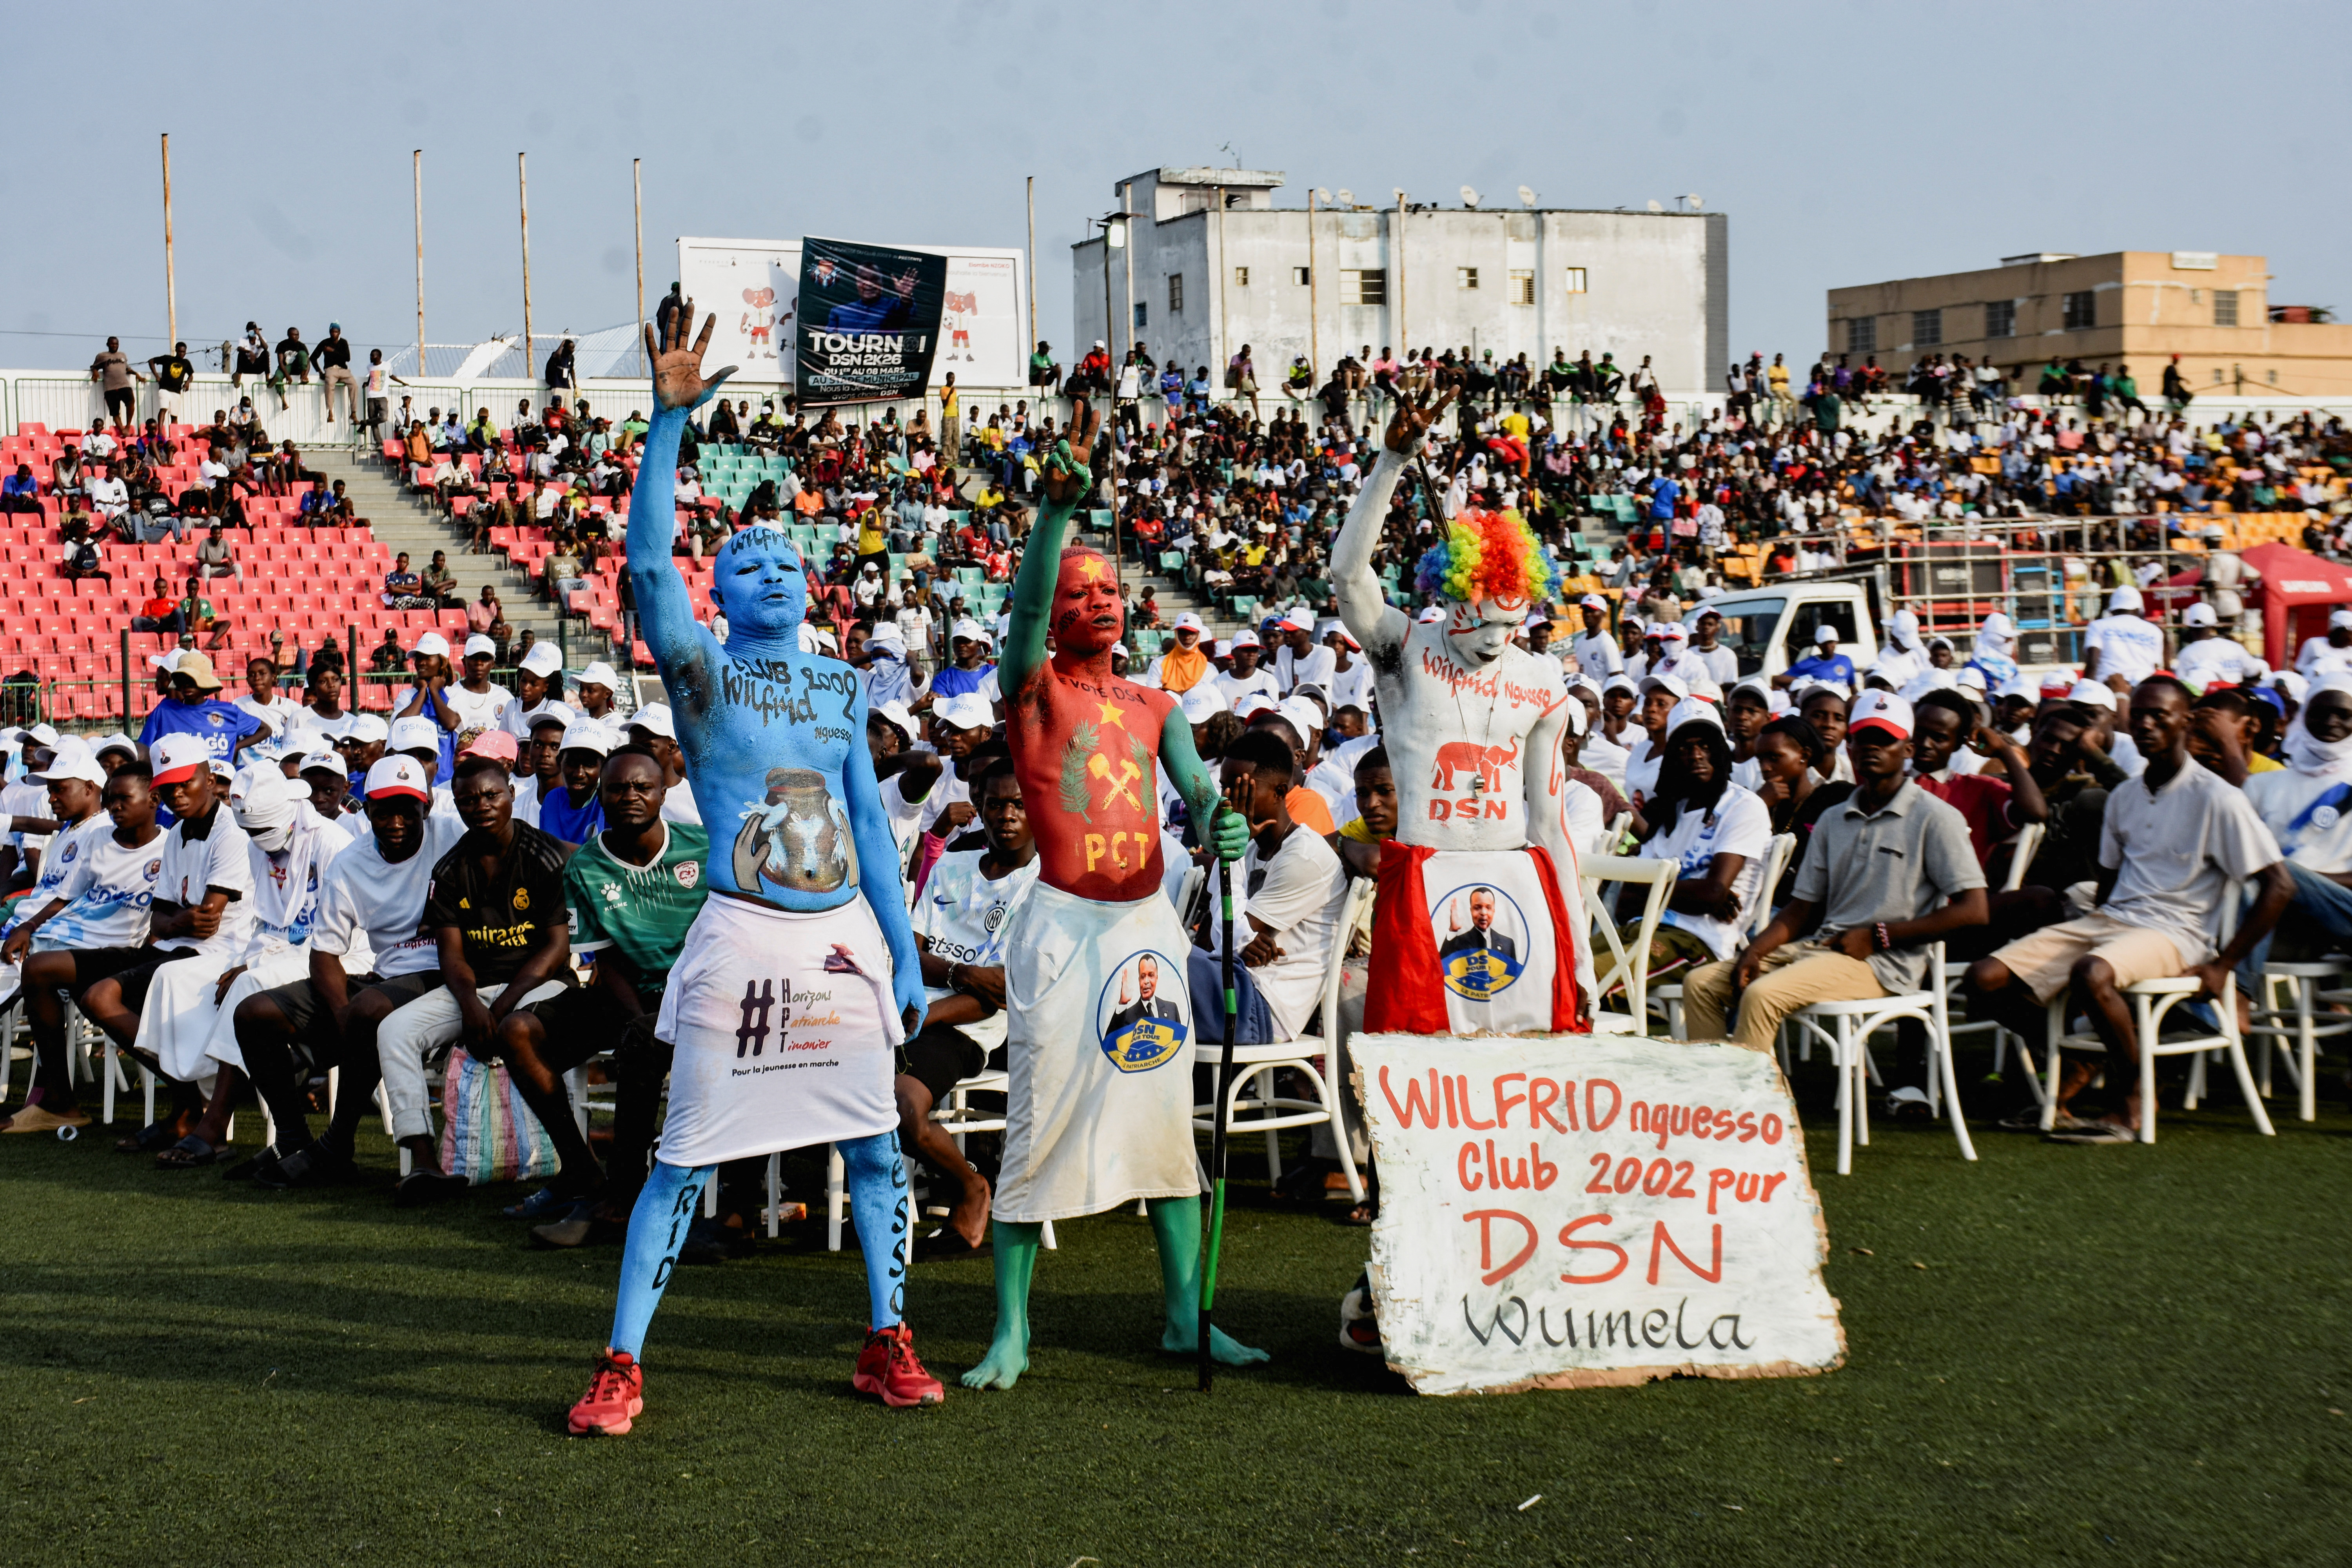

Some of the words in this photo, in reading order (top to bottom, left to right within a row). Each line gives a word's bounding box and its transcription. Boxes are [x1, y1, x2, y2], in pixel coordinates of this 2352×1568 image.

[829, 354, 862, 365] DSN
[863, 354, 902, 365] 2K26
[863, 373, 916, 383] MUNICIPAL
[731, 657, 792, 685] CLUB
[1071, 678, 1108, 698] VOTE
[1112, 686, 1147, 706] DSN
[401, 723, 433, 734] DSN26
[570, 726, 602, 738] DSN26
[1428, 798, 1507, 821] DSN
[1084, 831, 1149, 872] PCT
[604, 901, 628, 912] KELME
[781, 977, 832, 1010] Horizons
[781, 1007, 840, 1029] Patriarche
[780, 1031, 832, 1053] Timonier
[1132, 1024, 1157, 1038] DSN
[731, 1068, 751, 1077] Pour
[752, 1065, 761, 1074] la
[761, 1062, 797, 1074] jeunesse
[809, 1059, 839, 1067] marche
[1126, 1058, 1162, 1070] PATRIARCHE
[1378, 1065, 1623, 1135] WILFRID
[1630, 1100, 1783, 1151] nguesso
[1458, 1138, 1559, 1192] Club
[1584, 1152, 1696, 1199] 2002
[1707, 1167, 1787, 1215] pur
[1463, 1208, 1723, 1286] DSN
[1459, 1293, 1757, 1351] Wumela
